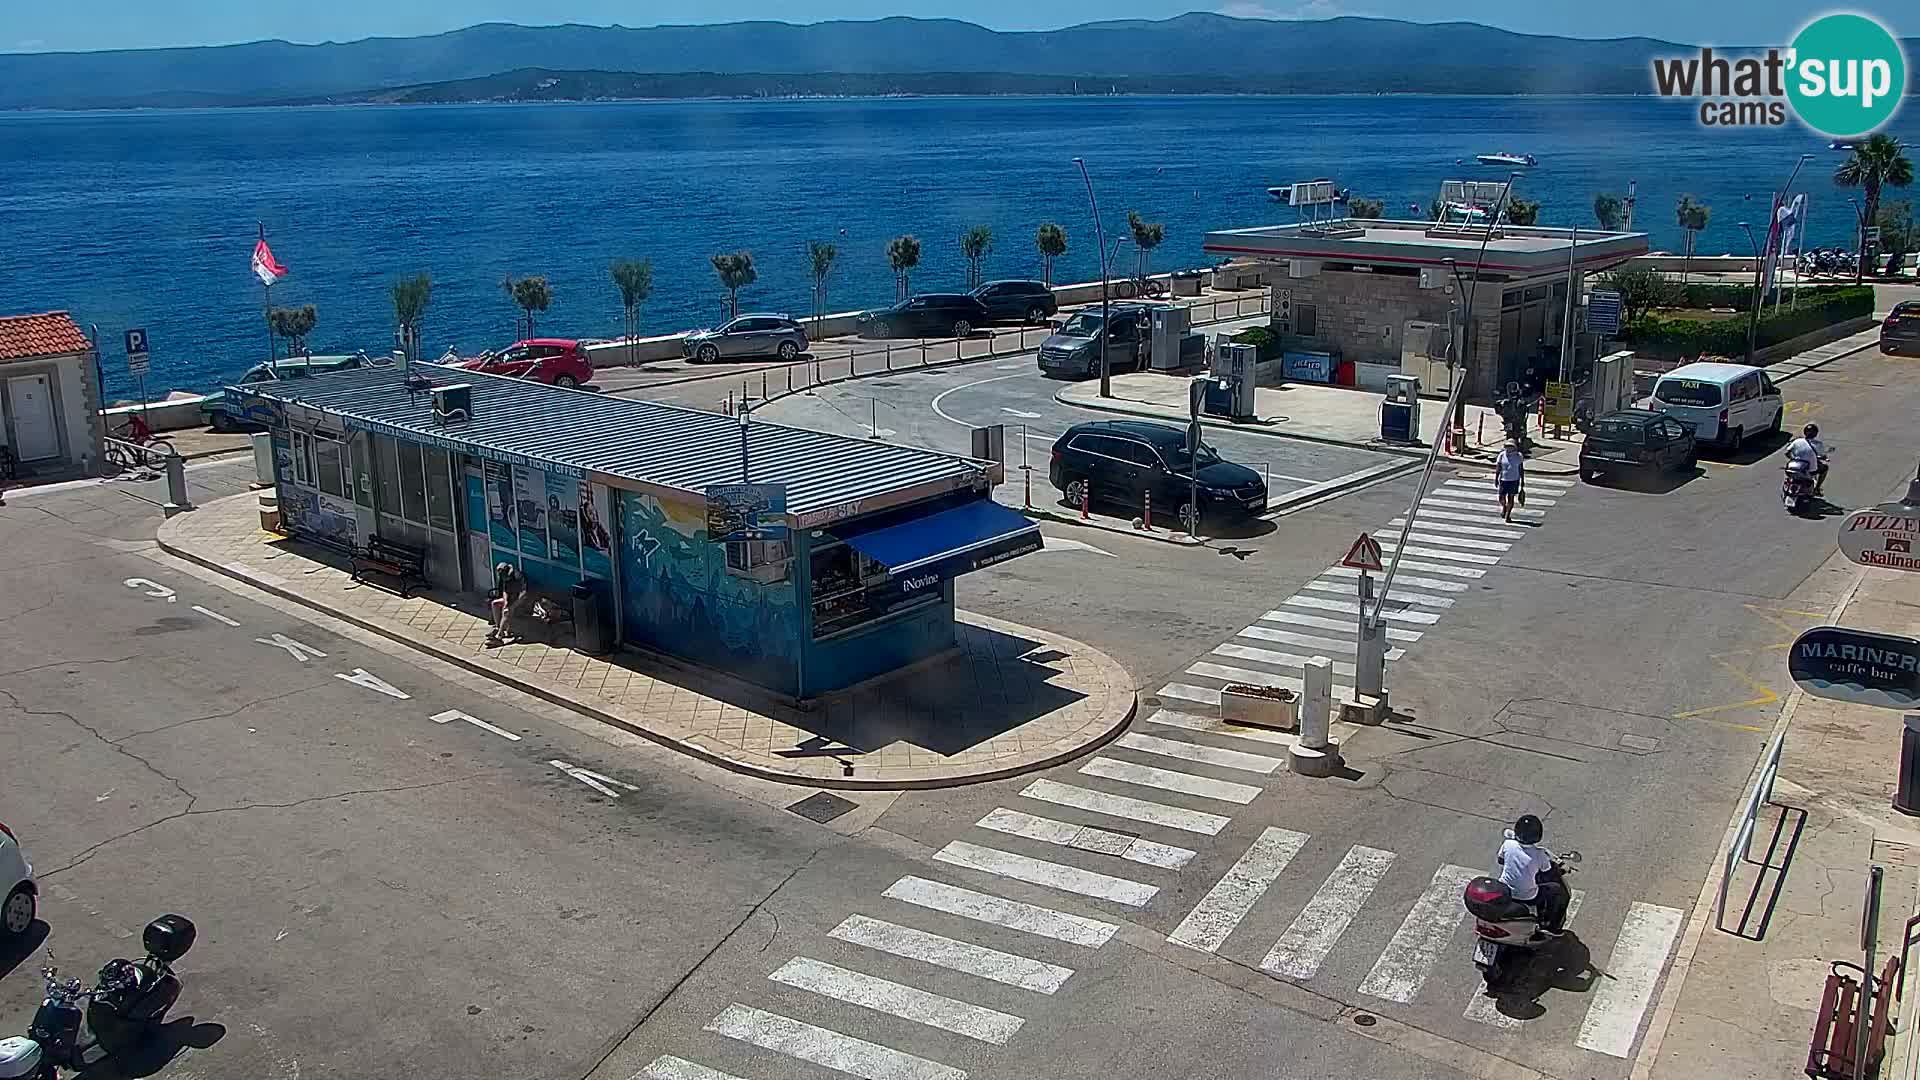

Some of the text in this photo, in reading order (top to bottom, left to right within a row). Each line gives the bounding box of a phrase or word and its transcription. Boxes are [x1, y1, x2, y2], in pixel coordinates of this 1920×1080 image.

[129, 332, 142, 351] P
[1681, 381, 1700, 389] TAXI
[437, 438, 467, 453] POSTAJA
[478, 447, 492, 459] BUS
[494, 451, 526, 465] STATION
[528, 458, 553, 473] TICKET
[556, 464, 582, 478] OFFICE
[1848, 515, 1920, 533] PIZZE
[1800, 643, 1920, 673] MARINER
[1829, 662, 1897, 680] caffe bar
